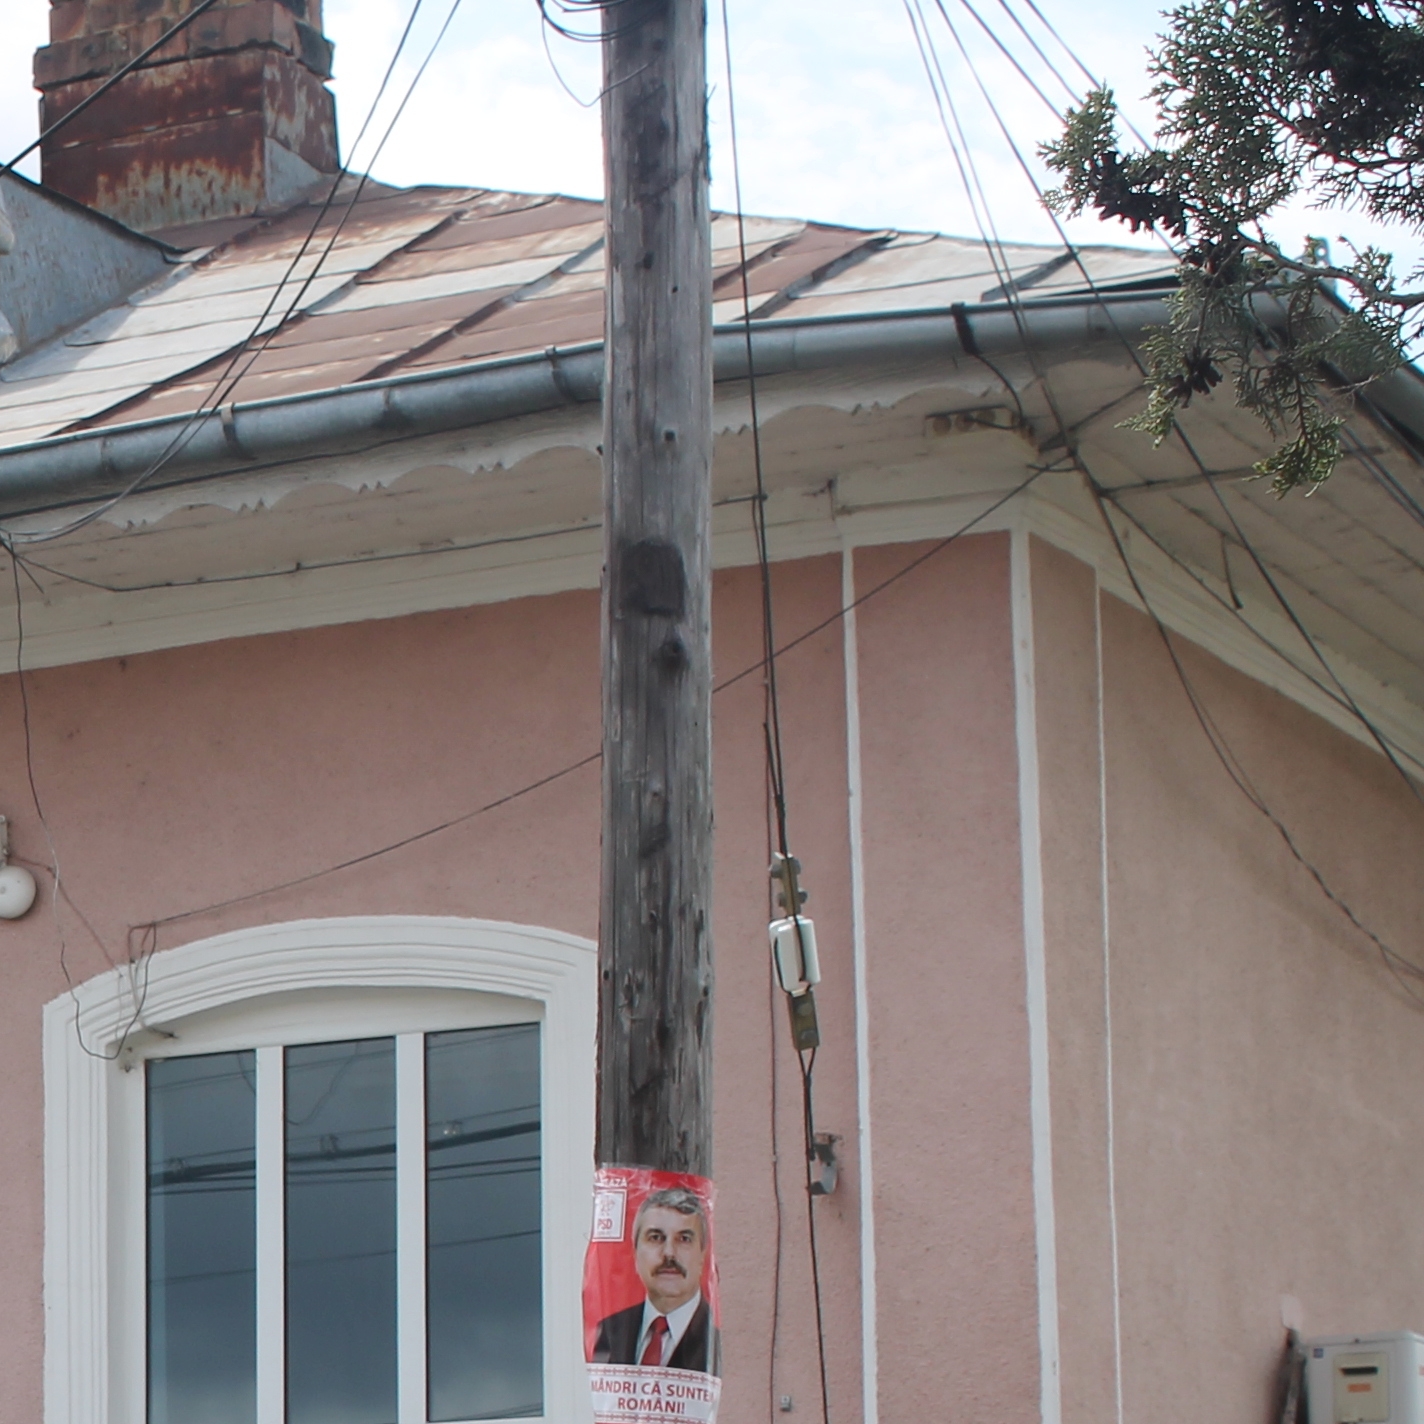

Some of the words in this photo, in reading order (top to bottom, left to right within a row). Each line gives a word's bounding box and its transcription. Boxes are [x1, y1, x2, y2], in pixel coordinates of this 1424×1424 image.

[641, 1380, 662, 1396] CĂ
[666, 1384, 714, 1403] SUNTE
[617, 1397, 685, 1414] ROMÂNI!
